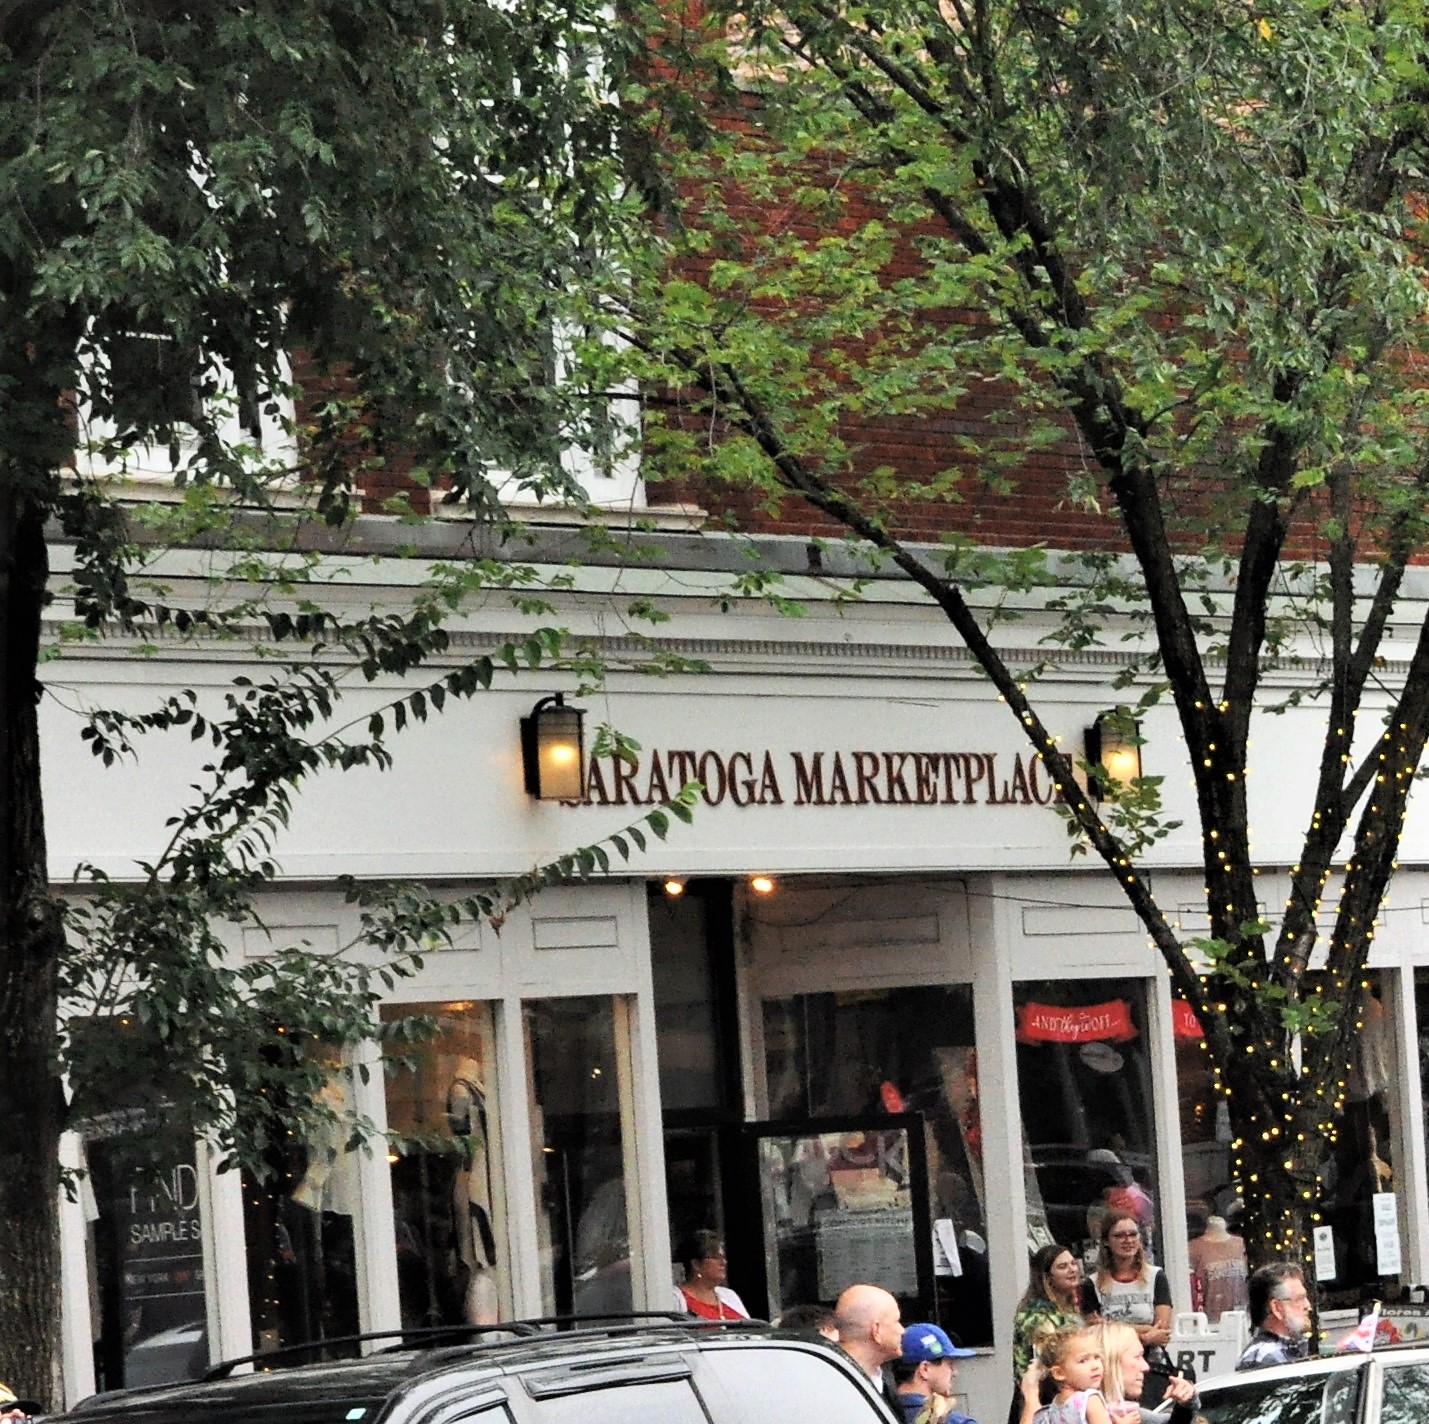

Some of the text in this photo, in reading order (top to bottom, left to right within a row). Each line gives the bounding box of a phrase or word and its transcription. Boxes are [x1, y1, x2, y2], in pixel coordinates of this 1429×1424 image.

[559, 748, 785, 807] ARATOGA
[131, 1220, 189, 1245] SAMPLE
[1382, 1308, 1422, 1317] lores
